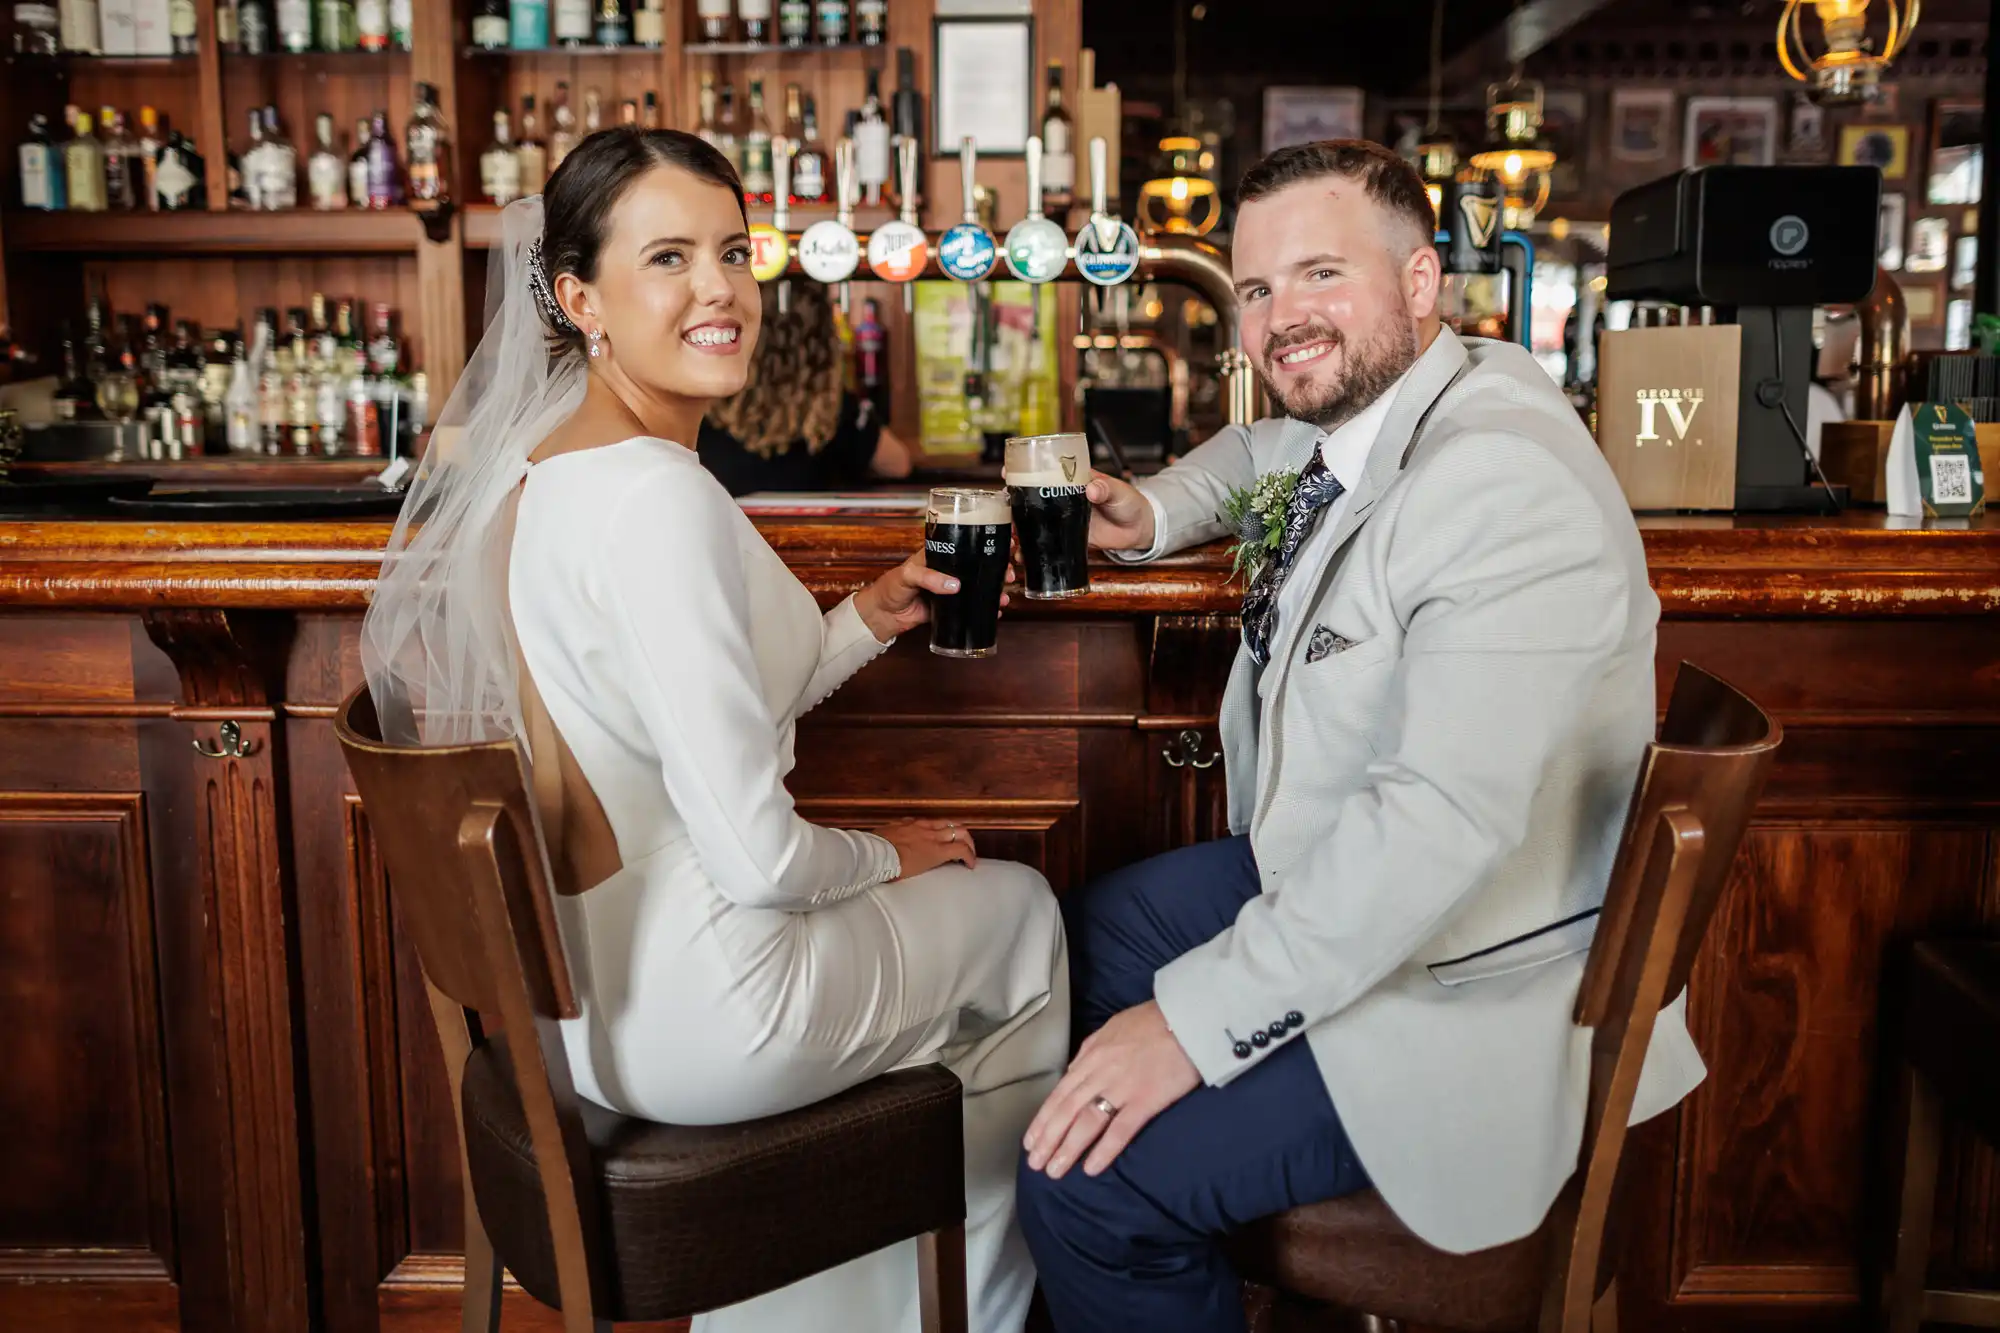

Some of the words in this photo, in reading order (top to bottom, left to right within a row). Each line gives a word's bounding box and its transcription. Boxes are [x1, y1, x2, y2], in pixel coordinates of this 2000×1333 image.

[1636, 397, 1704, 440] IV
[1039, 485, 1087, 499] GUINNE
[926, 539, 956, 554] NNESS
